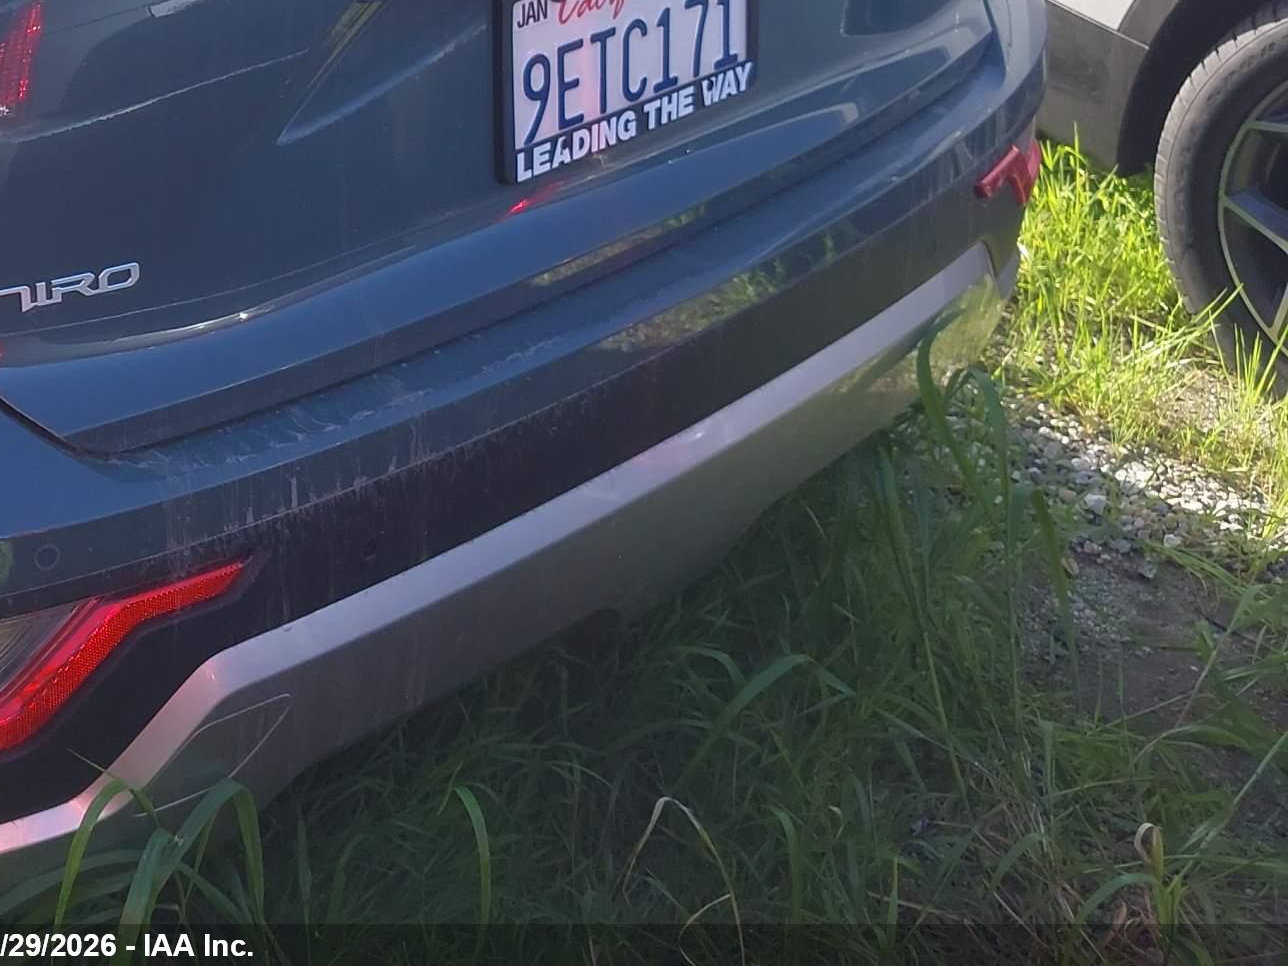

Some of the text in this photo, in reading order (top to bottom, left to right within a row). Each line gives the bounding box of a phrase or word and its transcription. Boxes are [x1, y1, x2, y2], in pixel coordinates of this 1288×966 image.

[516, 61, 754, 183] LEADING THE WAY
